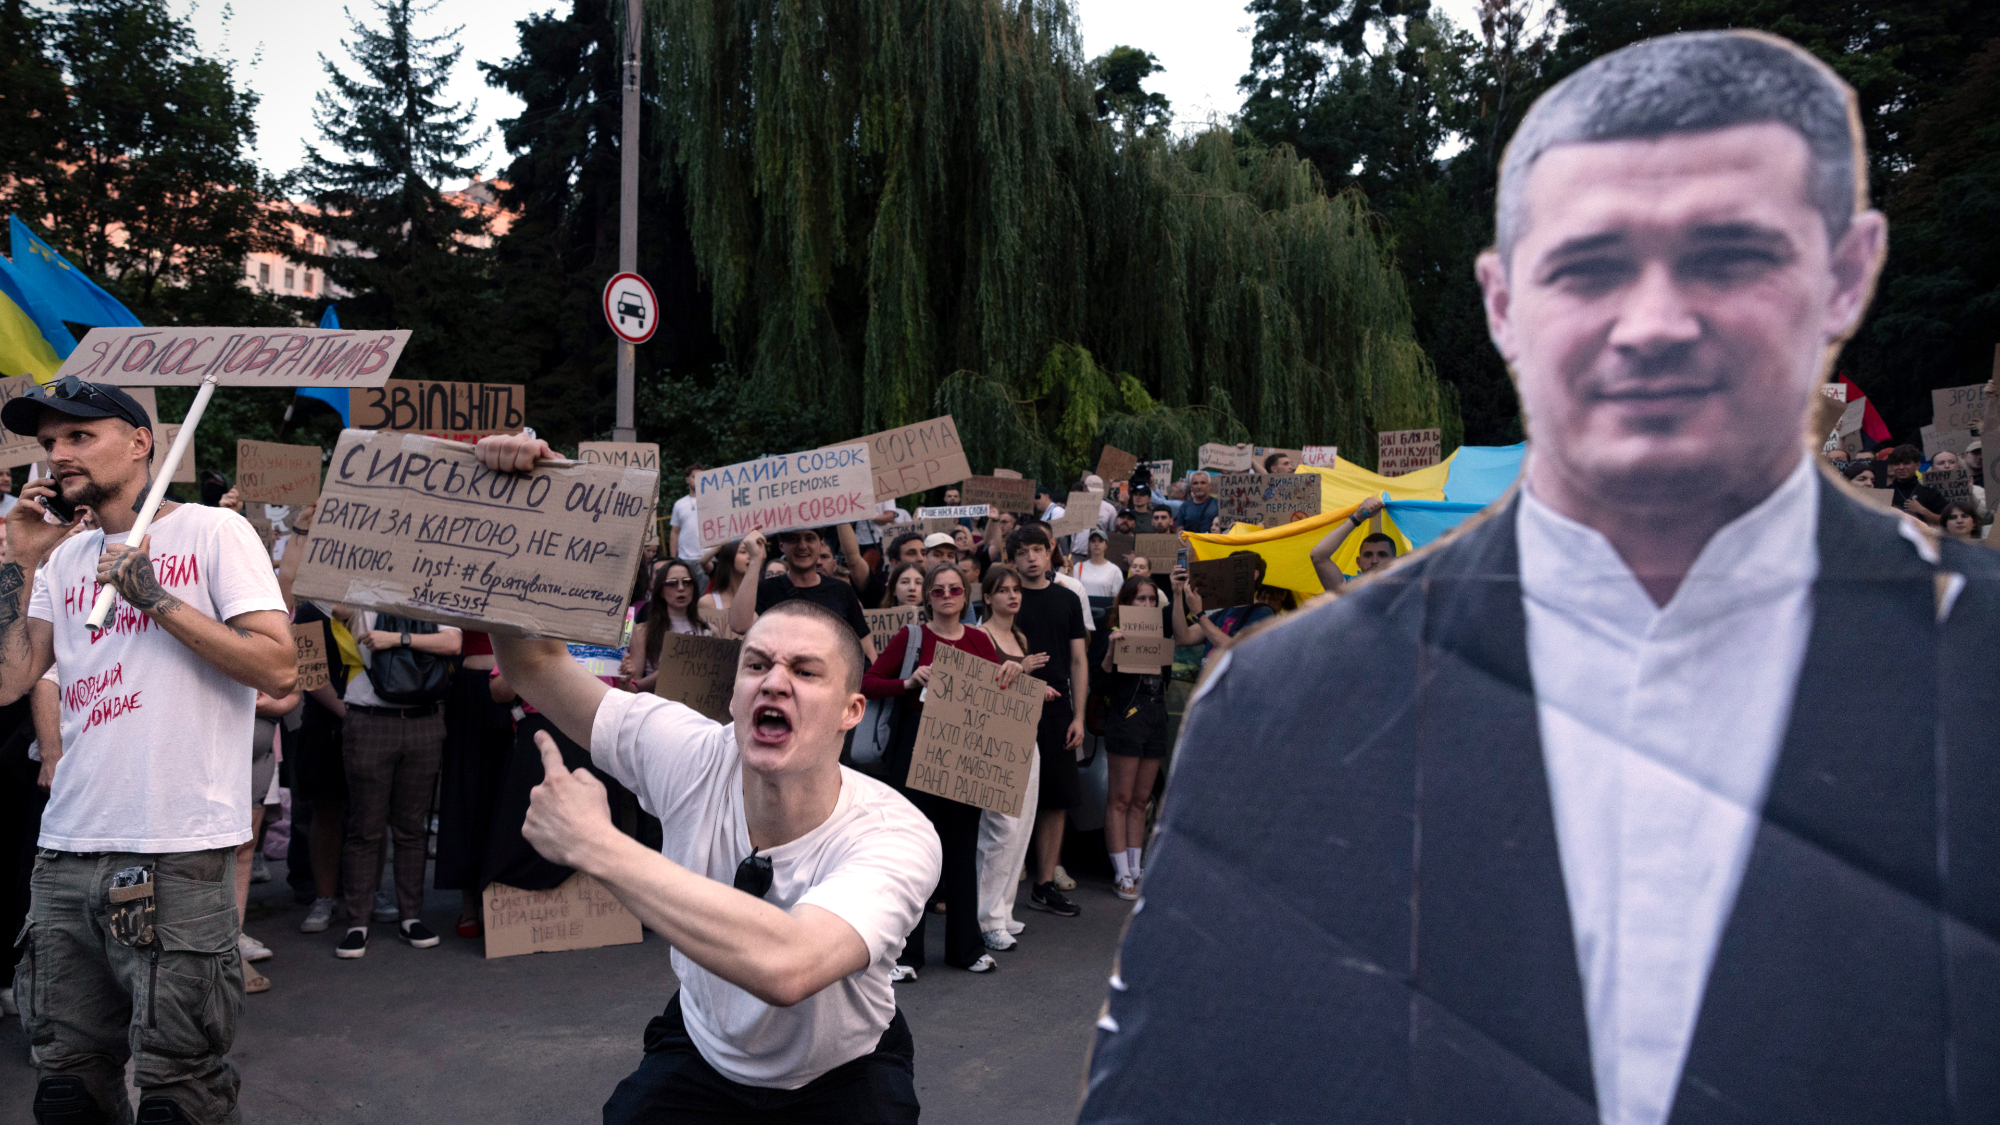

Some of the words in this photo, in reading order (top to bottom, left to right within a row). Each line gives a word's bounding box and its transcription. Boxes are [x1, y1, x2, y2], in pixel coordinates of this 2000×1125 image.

[77, 337, 110, 377] Я
[101, 332, 214, 377] ГОЛОС
[202, 333, 396, 380] ПОБРАТИМІВ
[872, 422, 957, 470] ФОРМА
[1380, 432, 1396, 446] ЯКІ
[1400, 431, 1440, 445] БЛЯДЬ
[338, 443, 551, 508] СИРСЬКОГО
[701, 456, 788, 494] МАЛИЙ
[797, 448, 864, 473] СОВОК
[876, 460, 940, 500] ДБР
[1220, 475, 1262, 486] ГАДАЛКА
[1382, 460, 1397, 468] НА
[731, 487, 751, 508] НЕ
[758, 475, 840, 501] ПЕРЕМОЖЕ
[317, 497, 380, 534] ВАТИ
[380, 509, 413, 536] ЗА
[418, 514, 520, 558] КАРТОЮ,
[527, 530, 558, 558] НЕ
[702, 503, 792, 542] ВЕЛИКИЙ
[798, 491, 866, 522] СОВОК
[307, 537, 394, 572] ТОНКОЮ.
[681, 661, 721, 677] ГЛУЗД
[934, 644, 966, 672] КАРМА
[965, 657, 987, 682] ДІЄ
[991, 665, 1039, 698] ТНІШЕ
[933, 671, 953, 702] ЗА
[956, 680, 1034, 725] ЗАСТОСУНОК
[925, 743, 952, 768] НАС
[963, 730, 1016, 762] КРАДУТЬ
[1019, 746, 1031, 765] У
[914, 764, 949, 795] РАНО
[531, 919, 584, 943] МЕНЕ
